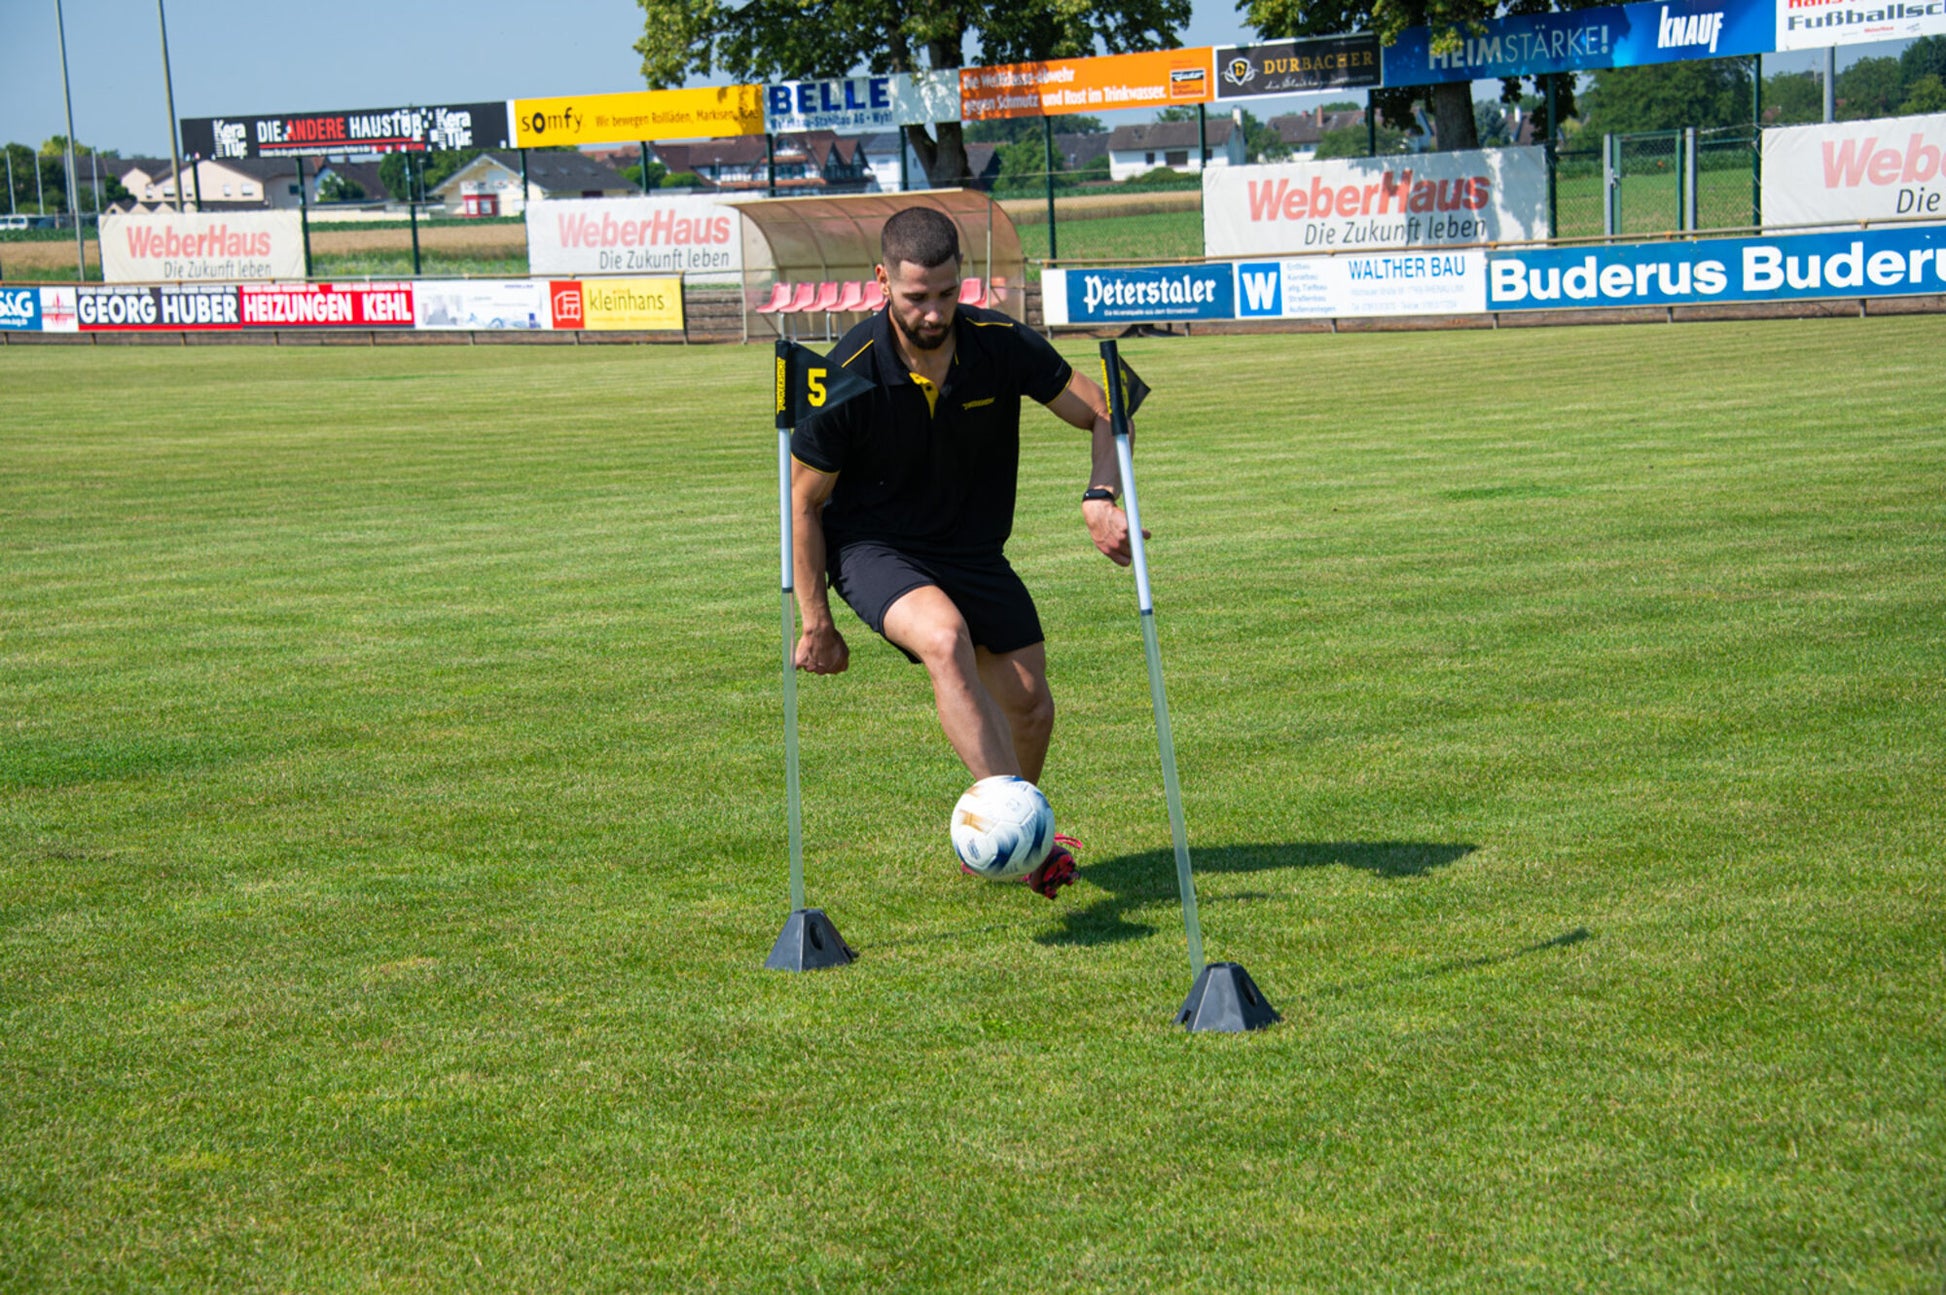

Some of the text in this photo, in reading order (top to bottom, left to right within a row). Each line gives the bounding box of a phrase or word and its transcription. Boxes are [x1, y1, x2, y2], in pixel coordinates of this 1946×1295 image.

[1658, 5, 1724, 53] KNAUF
[1788, 3, 1946, 31] Fußballsc
[1264, 51, 1374, 75] DURBACHER
[1429, 25, 1608, 70] HEIMSTÄRKE!
[769, 78, 891, 116] BELLE
[964, 98, 994, 116] gegen
[997, 93, 1039, 110] Schmutz
[1043, 90, 1062, 106] und
[1065, 89, 1087, 105] Rost
[1089, 88, 1102, 104] im
[1104, 86, 1167, 102] Trinkwasser.
[257, 120, 282, 143] DIE
[286, 117, 347, 141] ANDERE
[521, 107, 584, 133] somfy
[612, 114, 649, 129] bewegen
[854, 113, 865, 125] AG
[1822, 133, 1946, 189] Web
[1248, 168, 1492, 222] WeberHaus
[1896, 187, 1941, 214] Die
[126, 224, 272, 258] WeberHaus
[558, 209, 731, 248] WeberHaus
[1304, 214, 1486, 246] Die Zukunft leben
[164, 260, 272, 279] Die Zukunft leben
[600, 249, 730, 271] Die Zukunft leben
[1348, 255, 1466, 280] WALTHER BAU
[1083, 274, 1216, 314] Peterstaler
[1242, 272, 1277, 310] W
[1491, 255, 1728, 301] Buderus
[78, 292, 413, 324] GEORG HUBER HEIZUNGEN KEHL
[589, 289, 666, 312] kleinhans
[808, 368, 827, 407] 5
